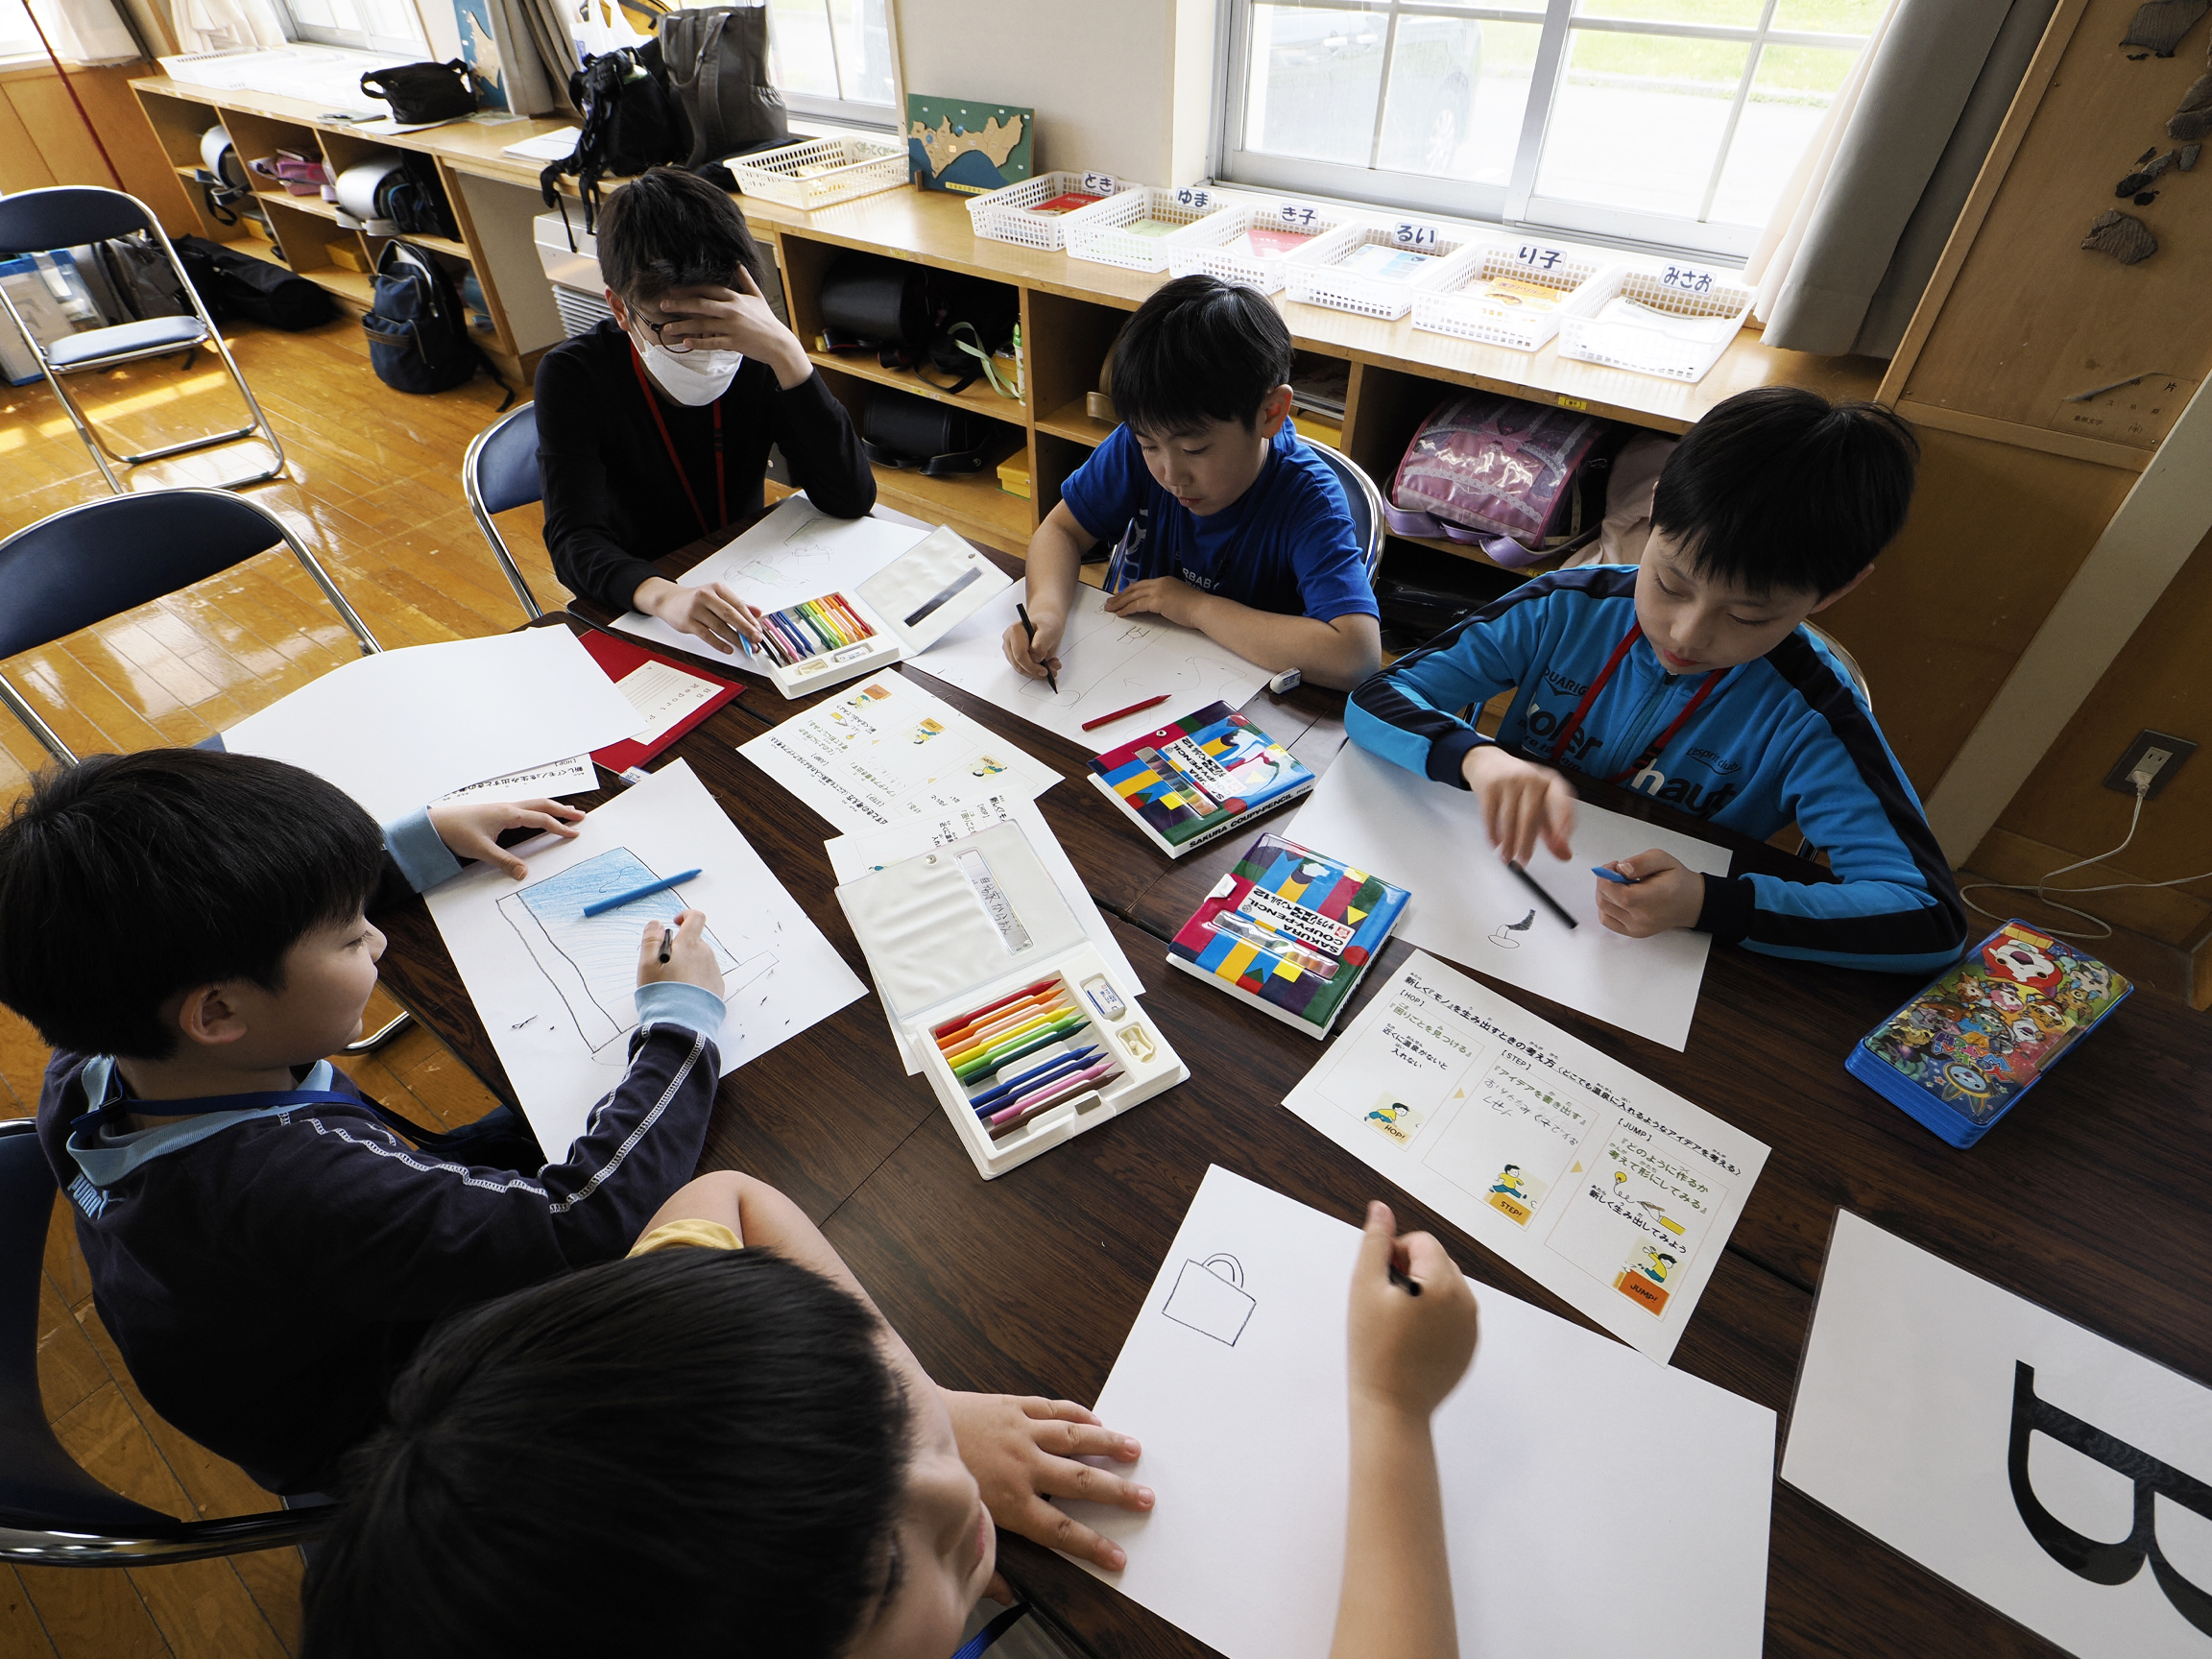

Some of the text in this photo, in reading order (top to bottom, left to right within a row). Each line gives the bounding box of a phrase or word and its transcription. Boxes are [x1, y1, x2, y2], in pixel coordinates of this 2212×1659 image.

[1084, 173, 1113, 193] とき
[1177, 189, 1210, 208] ゆま
[1281, 204, 1317, 226] き子
[1396, 224, 1436, 246] るい
[1518, 245, 1563, 270] り子
[1663, 266, 1713, 293] みさお
[1631, 757, 1738, 814] haut
[1189, 793, 1294, 849] SAKURA COUPY-PENCIL
[1247, 897, 1344, 947] COUPY-PENCIL
[1283, 924, 1339, 954] SAKURA
[1383, 1123, 1406, 1141] HOP!
[67, 1171, 103, 1218] PUMA
[1500, 1200, 1523, 1217] STEP!
[1629, 1284, 1658, 1304] JUMP!
[2008, 1358, 2212, 1639] B
